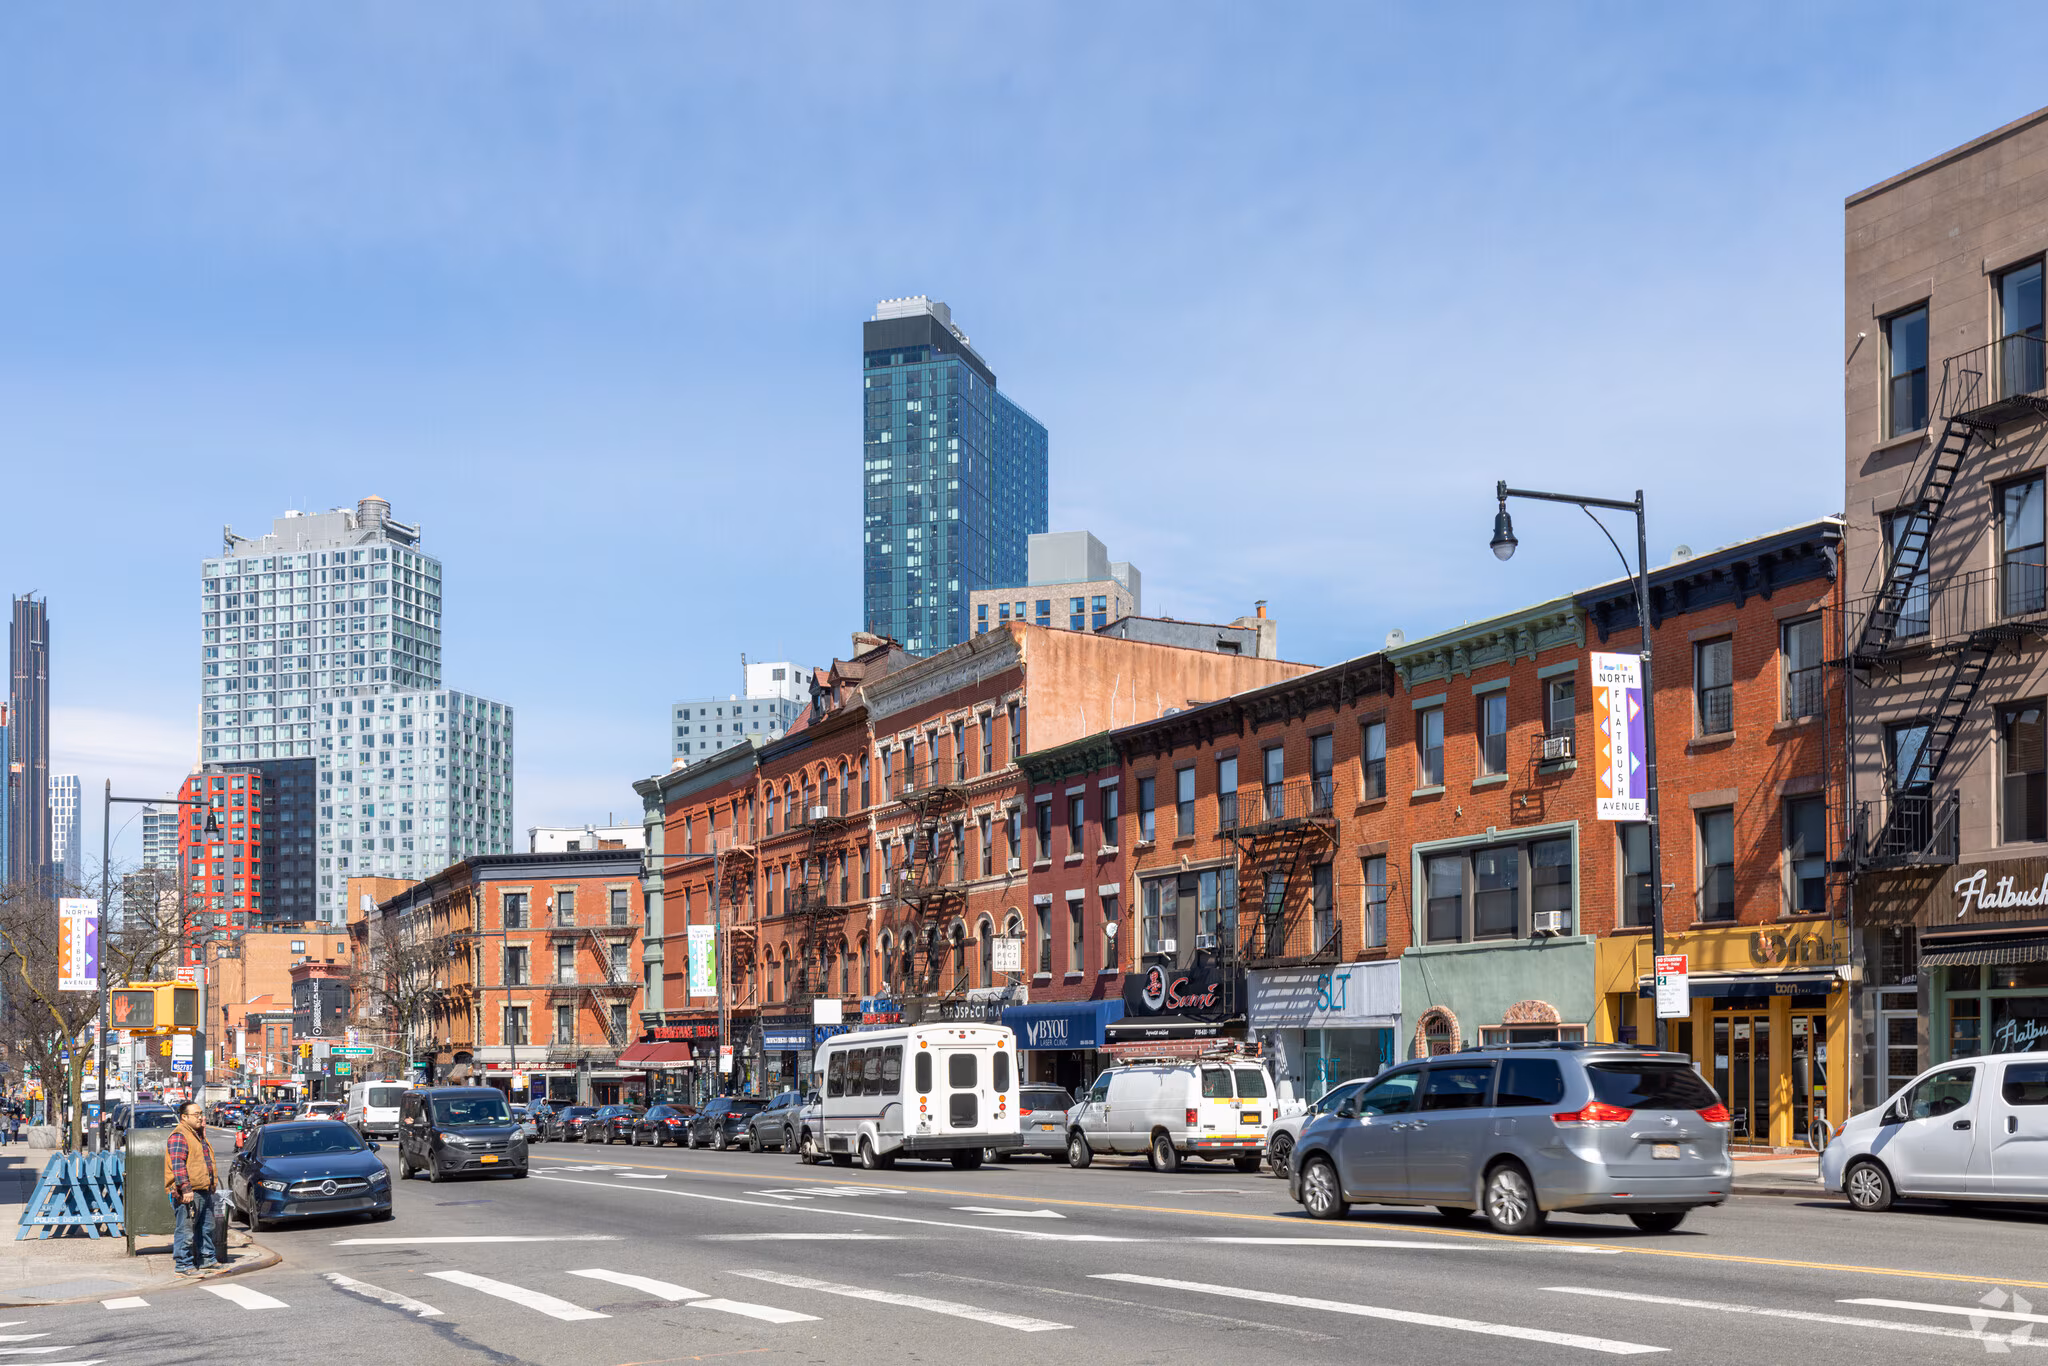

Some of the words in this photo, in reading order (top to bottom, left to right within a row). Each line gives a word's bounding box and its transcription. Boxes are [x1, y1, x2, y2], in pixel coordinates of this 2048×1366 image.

[1599, 673, 1634, 684] NORTH
[1614, 690, 1624, 796] FLATBUSH
[1602, 802, 1640, 811] AVENUE
[1954, 868, 2048, 918] Flatbush
[1166, 977, 1218, 1009] Sumi
[1318, 973, 1351, 1011] SLT
[1775, 982, 1797, 994] born
[944, 1004, 985, 1018] PROSPECT
[1039, 1019, 1068, 1038] BYOU
[1317, 1058, 1340, 1082] SLT
